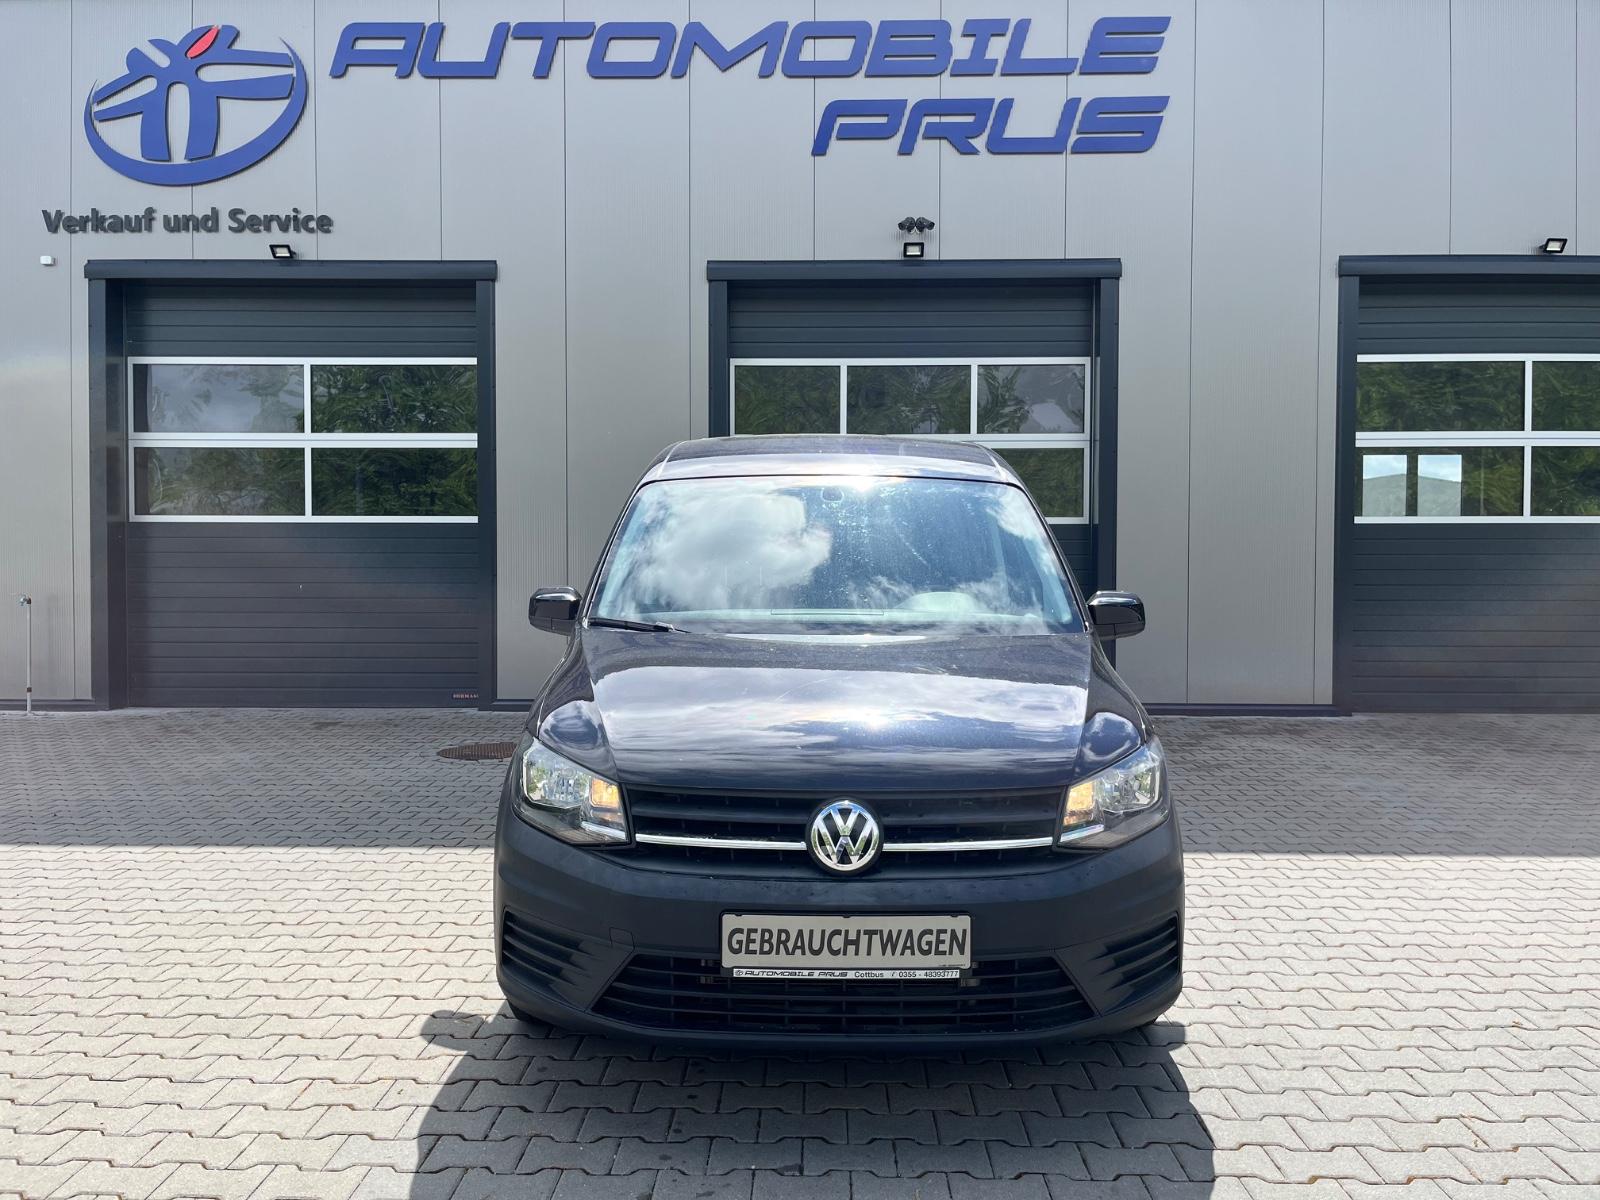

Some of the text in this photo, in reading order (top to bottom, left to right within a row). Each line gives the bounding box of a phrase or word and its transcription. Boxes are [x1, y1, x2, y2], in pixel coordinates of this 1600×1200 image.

[328, 16, 1172, 80] AUTOMOBILE
[811, 95, 1171, 156] PRUS
[42, 206, 334, 234] Verkauf und Service
[727, 927, 968, 957] GEBRAUCHTWAGEN
[744, 970, 815, 978] AUTOMOBILE
[817, 971, 849, 979] PRUS
[854, 970, 885, 978] Cottbus
[898, 970, 917, 978] 0355
